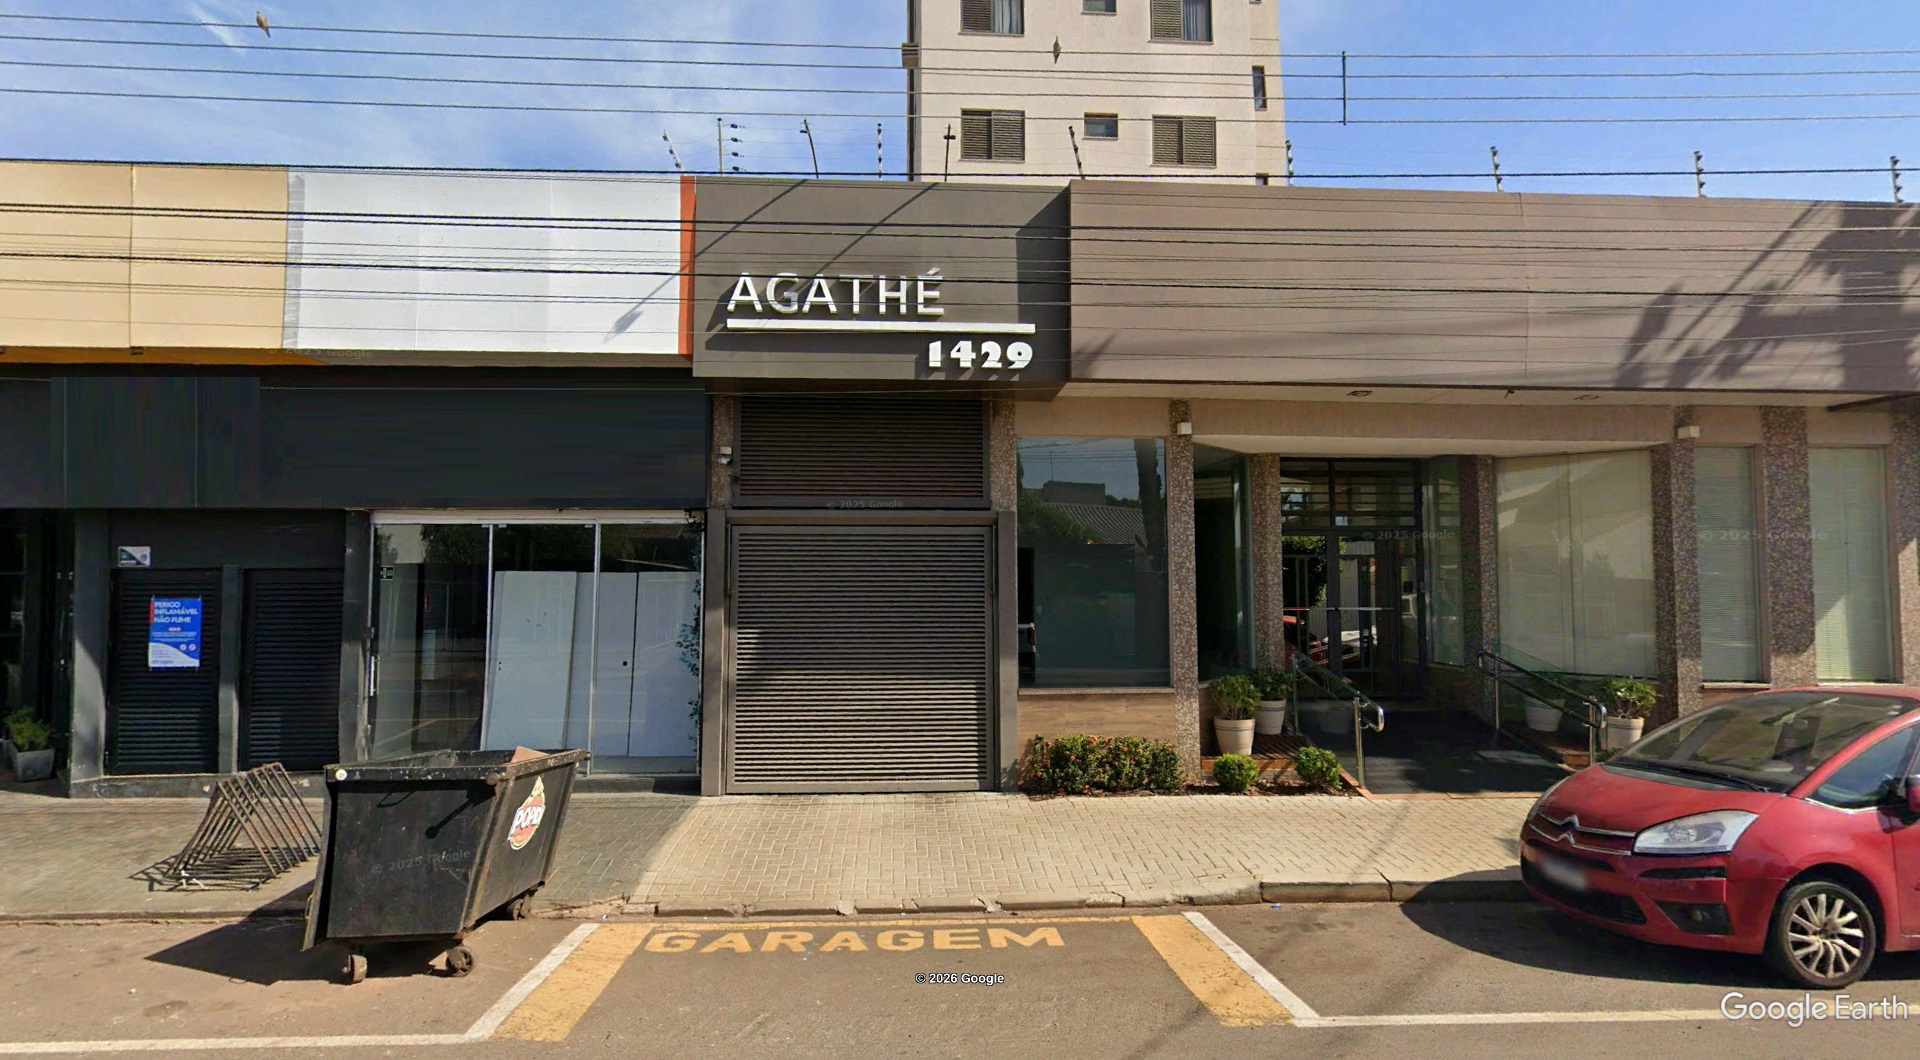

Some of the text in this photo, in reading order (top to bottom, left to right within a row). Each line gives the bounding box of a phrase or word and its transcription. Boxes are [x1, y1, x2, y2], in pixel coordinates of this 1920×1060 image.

[727, 268, 944, 315] AGATHÉ
[929, 340, 1034, 369] 1429
[154, 607, 199, 615] INFLAMÁVEL
[154, 615, 170, 623] NÃO
[643, 926, 1066, 953] GARAGEM
